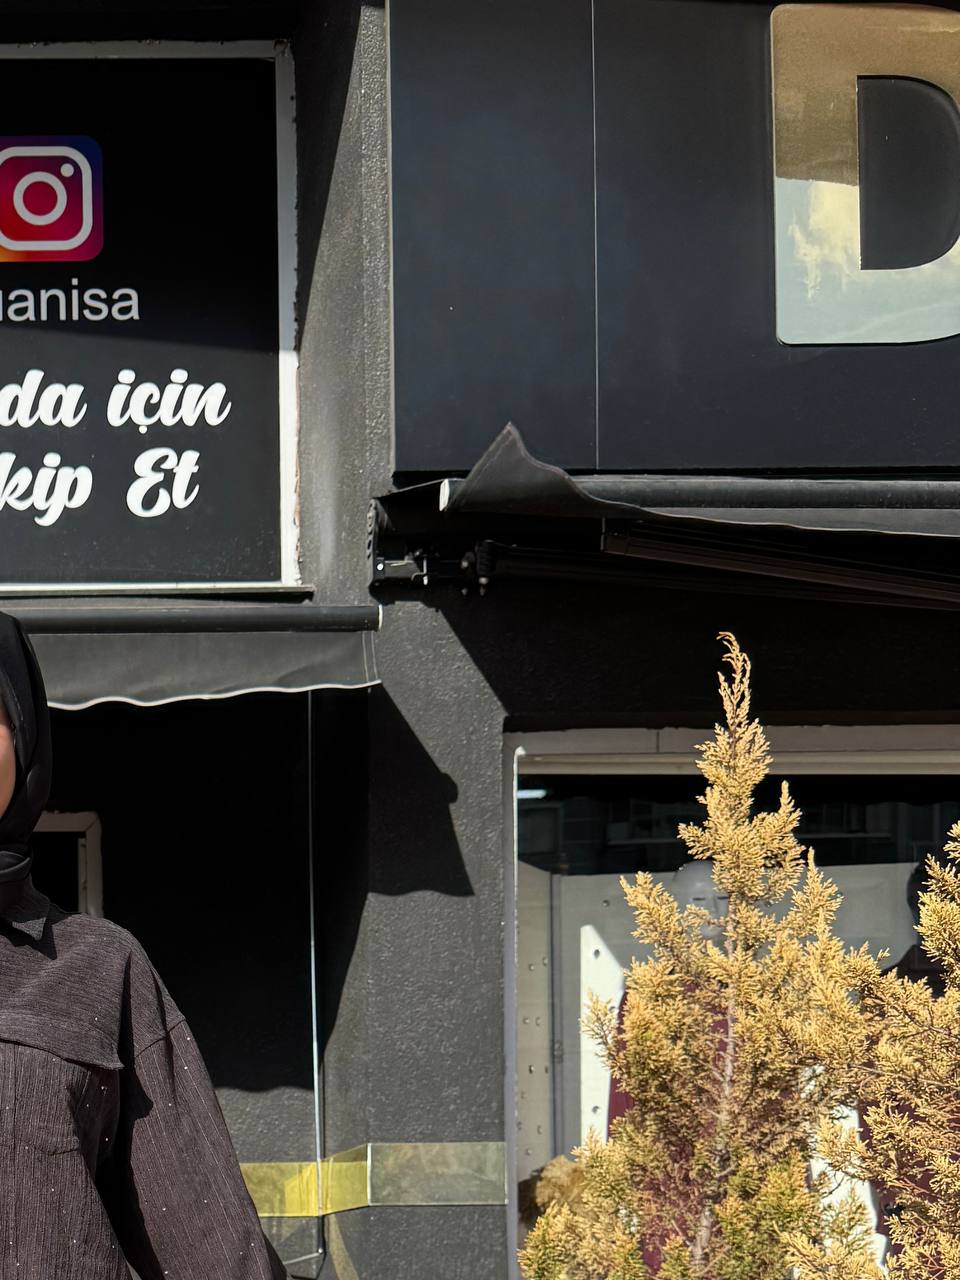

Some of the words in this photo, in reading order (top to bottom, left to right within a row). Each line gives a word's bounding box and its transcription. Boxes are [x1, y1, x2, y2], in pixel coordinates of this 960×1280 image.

[770, 3, 960, 346] D
[106, 368, 232, 435] için
[125, 446, 201, 518] Et
